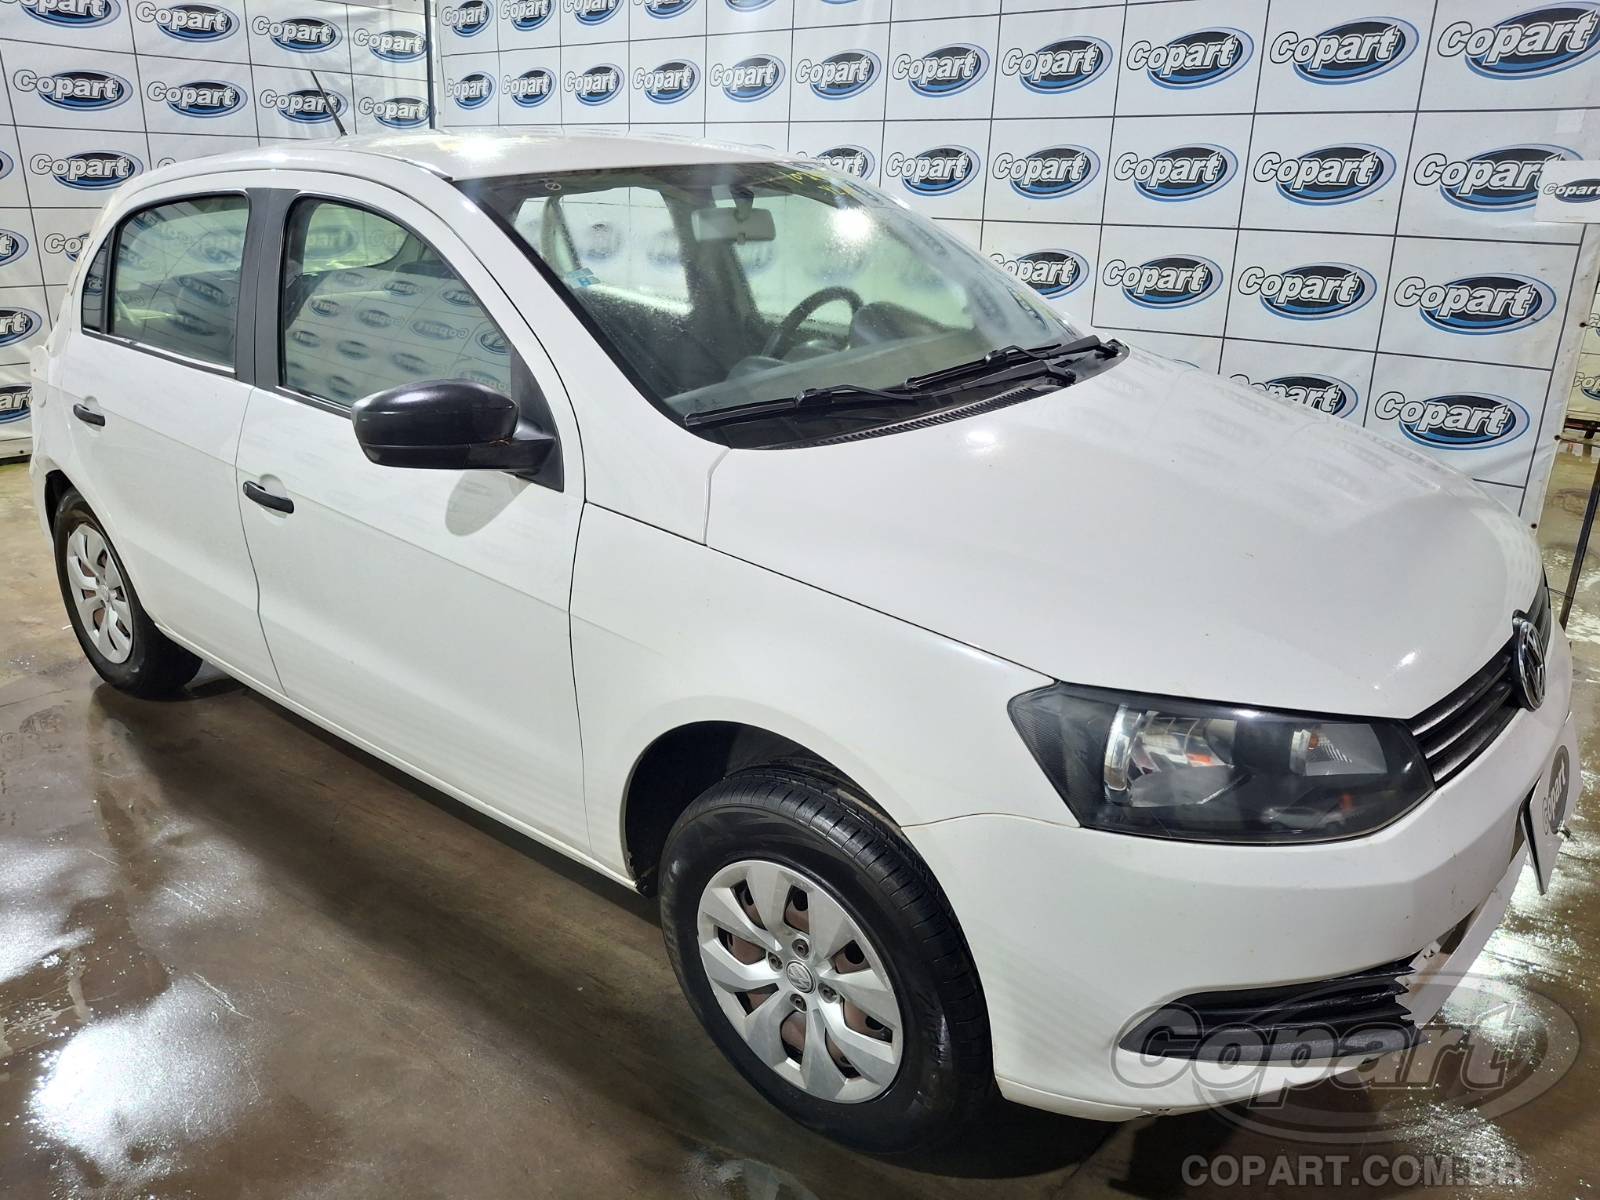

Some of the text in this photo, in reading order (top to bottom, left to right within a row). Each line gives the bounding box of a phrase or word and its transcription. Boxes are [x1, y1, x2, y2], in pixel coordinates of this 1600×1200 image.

[2, 0, 105, 17] part
[135, 1, 228, 32] Copart
[441, 3, 487, 30] Copart
[252, 16, 333, 44] Copart
[353, 28, 425, 54] Copart
[1437, 10, 1599, 65] Copart
[1002, 43, 1099, 83] Copart
[1127, 35, 1238, 78] Copart
[1270, 24, 1401, 72] Copart
[564, 66, 617, 97] Copart
[632, 65, 694, 96] Copart
[710, 59, 777, 92] Copart
[796, 56, 872, 89] Copart
[893, 50, 978, 86] Copart
[13, 69, 119, 100] Copart
[147, 81, 235, 108] Copart
[446, 77, 489, 102] Copart
[502, 74, 549, 98] Copart
[260, 89, 338, 115] Copart
[358, 97, 428, 120] Copart
[30, 153, 131, 182] Copart
[886, 152, 969, 184] Copart
[992, 152, 1086, 188] Copart
[1114, 151, 1223, 190] Copart
[1254, 152, 1378, 192] Copart
[1102, 259, 1210, 298] Copart
[1238, 267, 1362, 306] Copart
[1394, 276, 1538, 317] Copart
[1375, 391, 1510, 435] Copart
